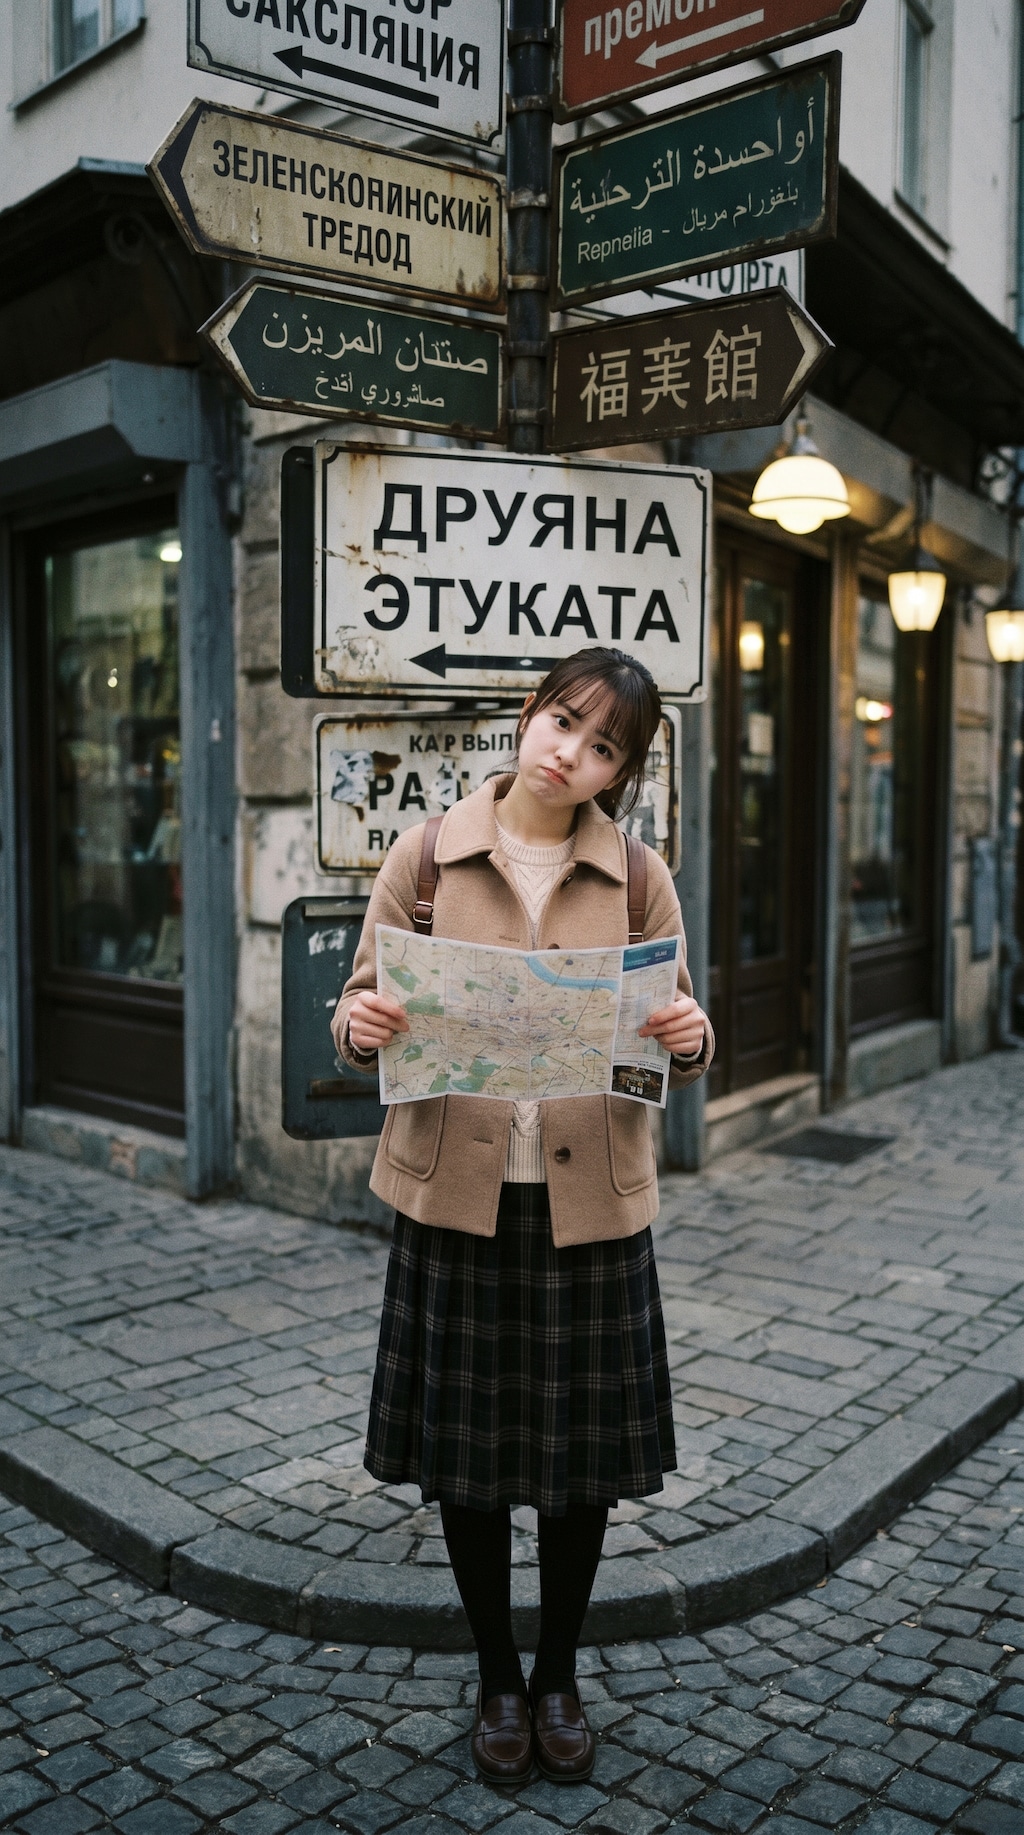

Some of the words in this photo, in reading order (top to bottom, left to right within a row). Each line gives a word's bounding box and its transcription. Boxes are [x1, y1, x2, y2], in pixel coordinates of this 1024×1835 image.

[303, 211, 412, 274] ТРЕДОД
[373, 482, 682, 558] ДРУЯНА
[363, 574, 681, 643] ЭТУКАТА
